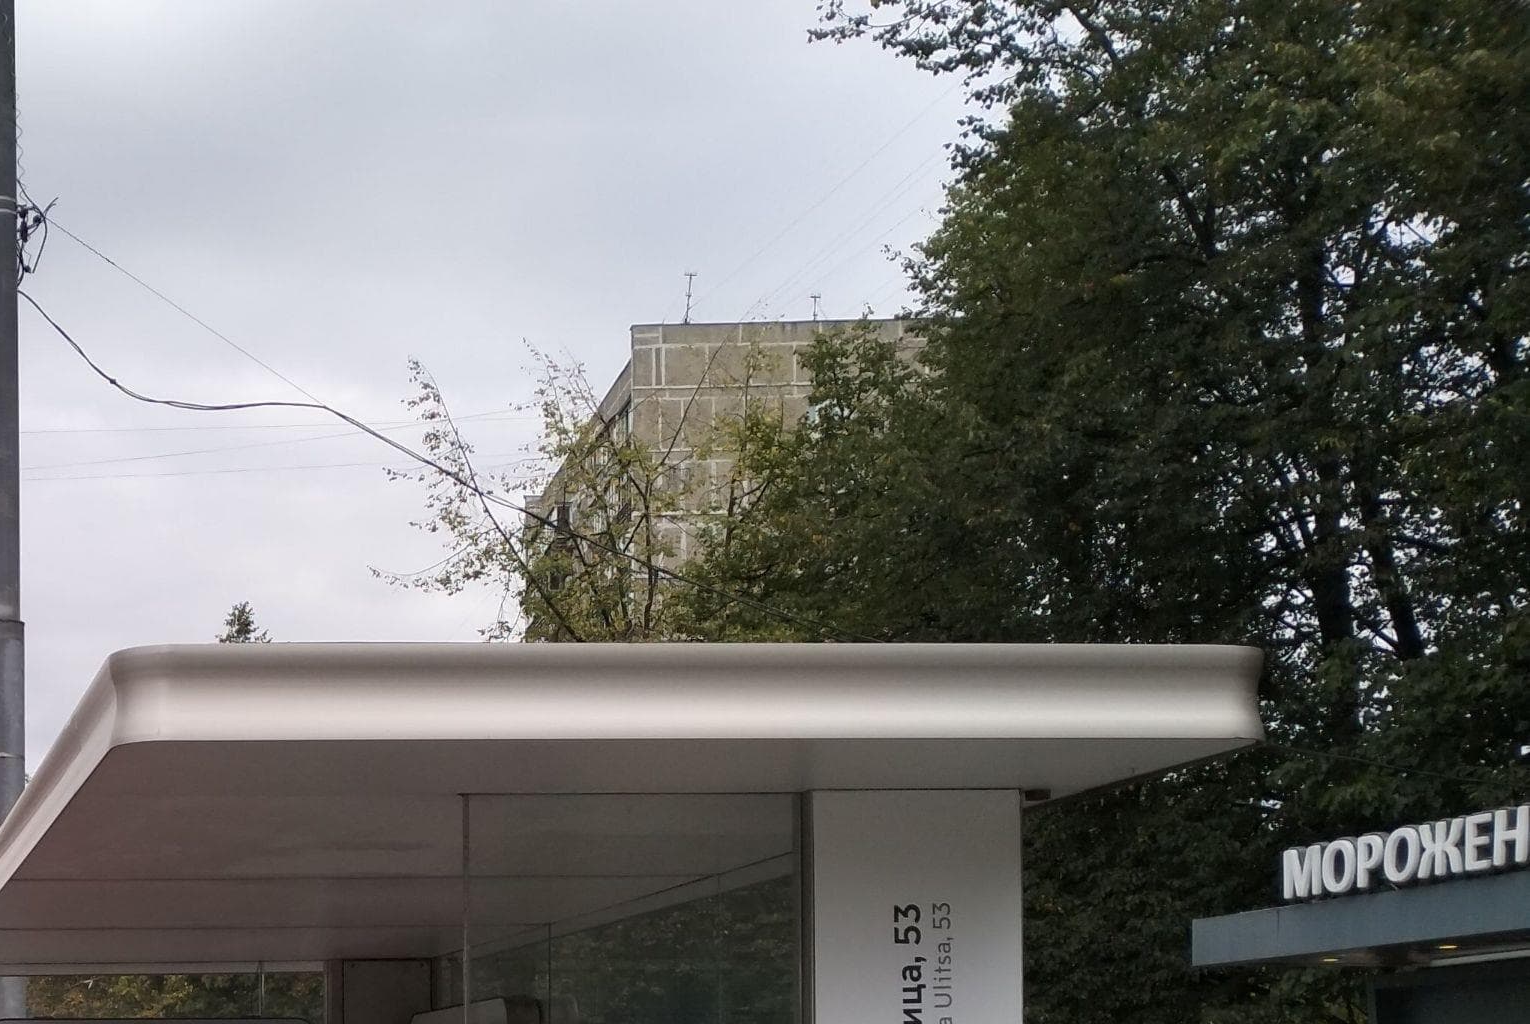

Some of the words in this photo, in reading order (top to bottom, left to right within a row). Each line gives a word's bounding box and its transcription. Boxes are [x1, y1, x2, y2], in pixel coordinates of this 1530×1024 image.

[1282, 804, 1530, 900] МОРОЖЕН
[894, 903, 922, 946] 53
[931, 902, 952, 931] 53
[934, 936, 954, 1009] Ulitsa,
